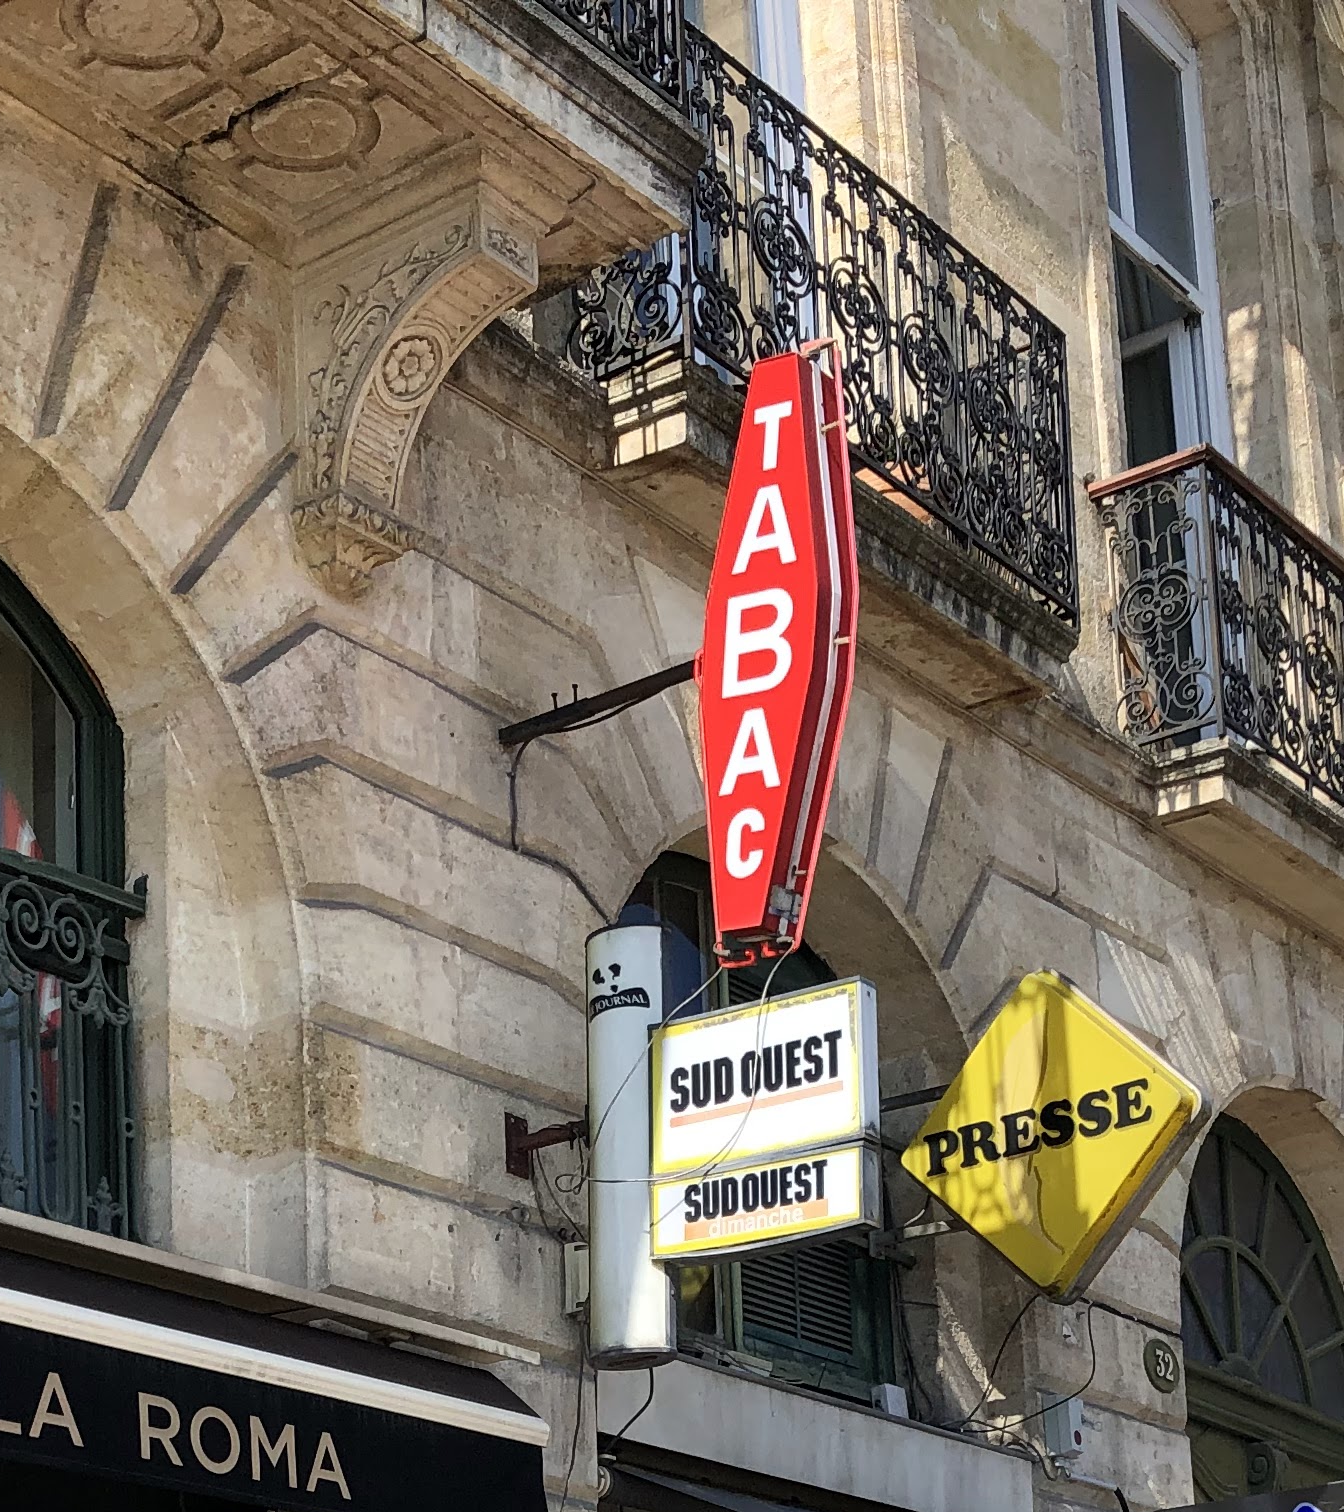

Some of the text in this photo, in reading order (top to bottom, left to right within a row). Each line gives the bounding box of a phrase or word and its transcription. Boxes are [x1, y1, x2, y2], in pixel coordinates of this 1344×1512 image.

[719, 399, 797, 879] TABAC
[595, 993, 647, 1013] JOURNAL
[670, 1029, 842, 1112] SUD OUEST
[923, 1078, 1152, 1177] PRESSE
[708, 1206, 805, 1238] dimanche
[1155, 1349, 1174, 1382] 32
[140, 1393, 351, 1500] ROMA
